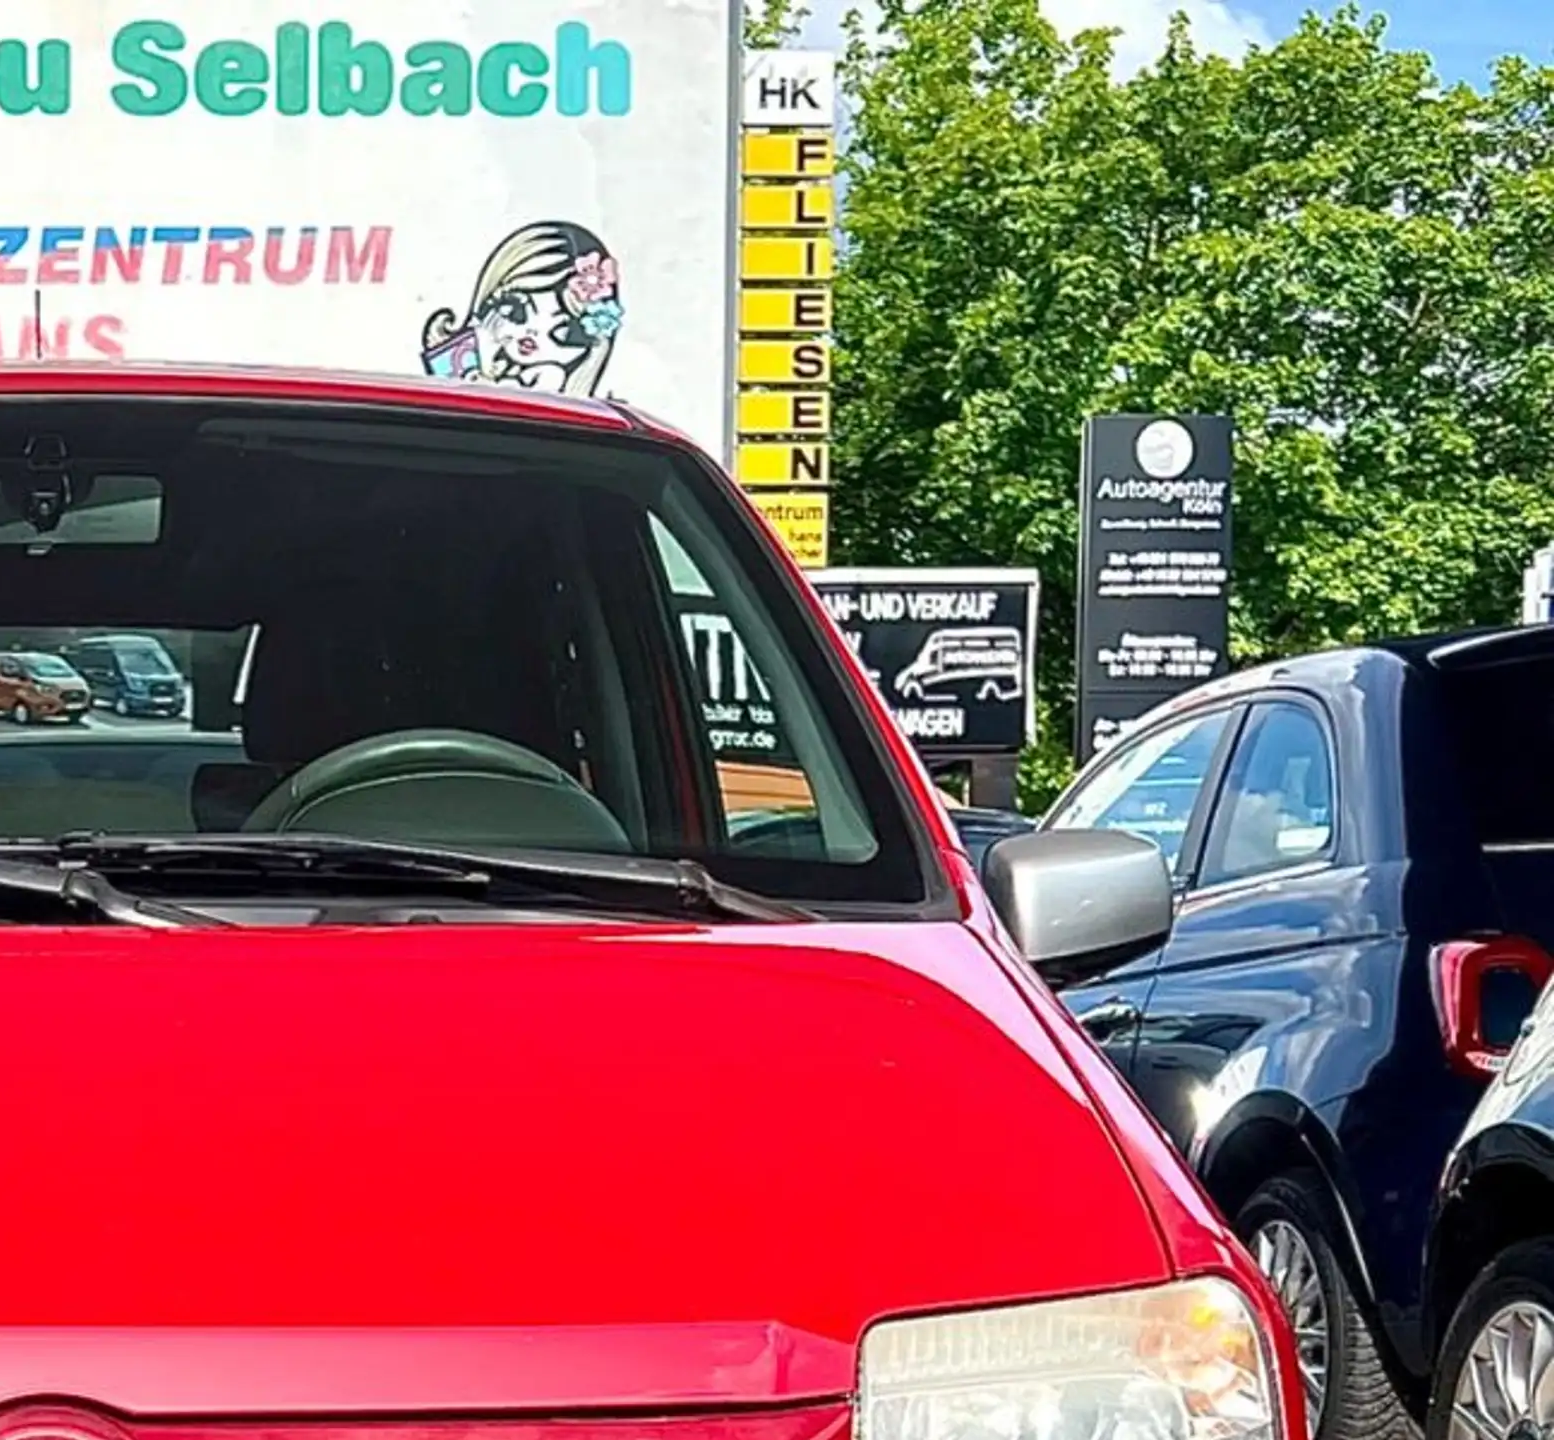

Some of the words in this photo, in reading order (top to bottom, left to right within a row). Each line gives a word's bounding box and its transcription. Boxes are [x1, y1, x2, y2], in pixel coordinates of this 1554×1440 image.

[110, 19, 632, 117] Selbach
[759, 77, 821, 109] HK
[789, 138, 828, 482] FLIESEN
[1097, 478, 1227, 503] Autoagentur
[860, 594, 904, 620] UND
[906, 593, 997, 620] VERKAUF
